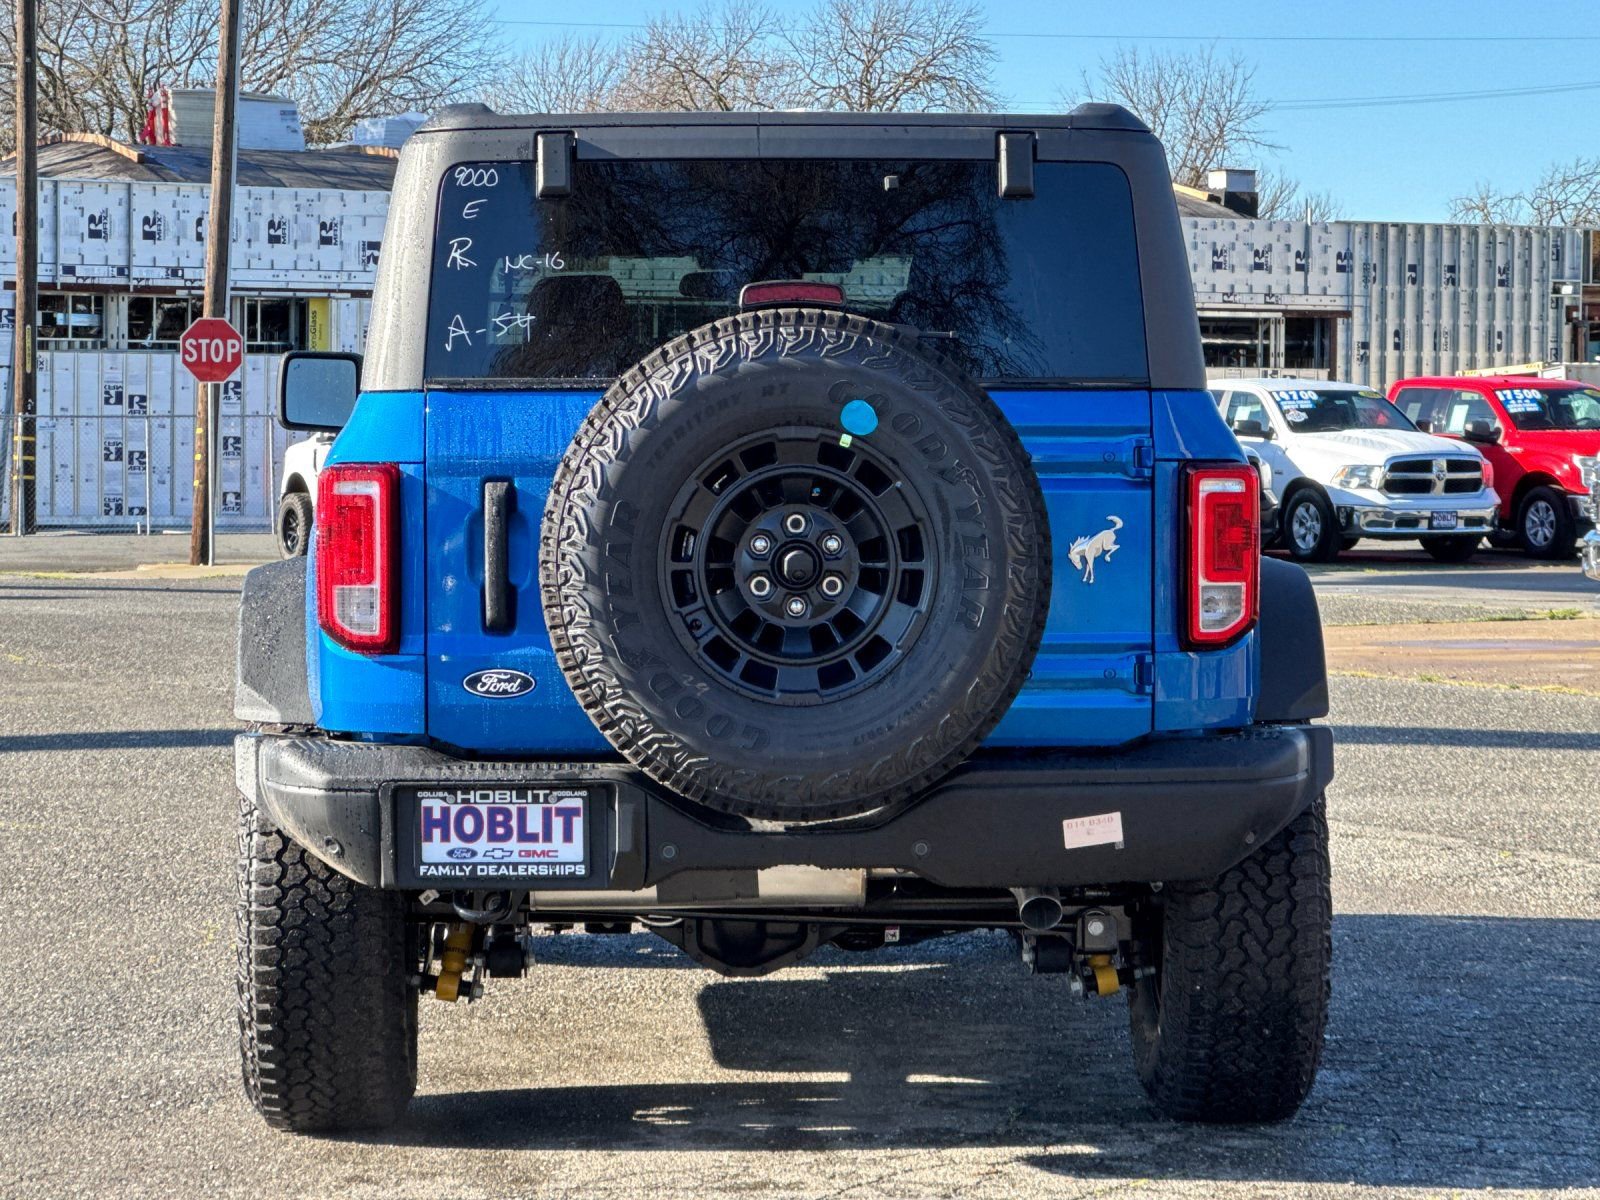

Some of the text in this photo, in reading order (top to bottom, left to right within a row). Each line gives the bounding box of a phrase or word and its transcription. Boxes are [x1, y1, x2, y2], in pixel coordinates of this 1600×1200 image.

[455, 167, 498, 186] 9000
[463, 199, 488, 218] E
[184, 338, 240, 363] STOP
[828, 378, 991, 633] GOODYEAR
[605, 498, 770, 750] GOODYEAR
[477, 673, 522, 692] Ford
[457, 790, 549, 804] HOBLIT
[421, 805, 581, 844] HOBLIT
[451, 849, 559, 860] Ford GMC
[419, 865, 586, 876] FAMILY DEALERSHIPS
